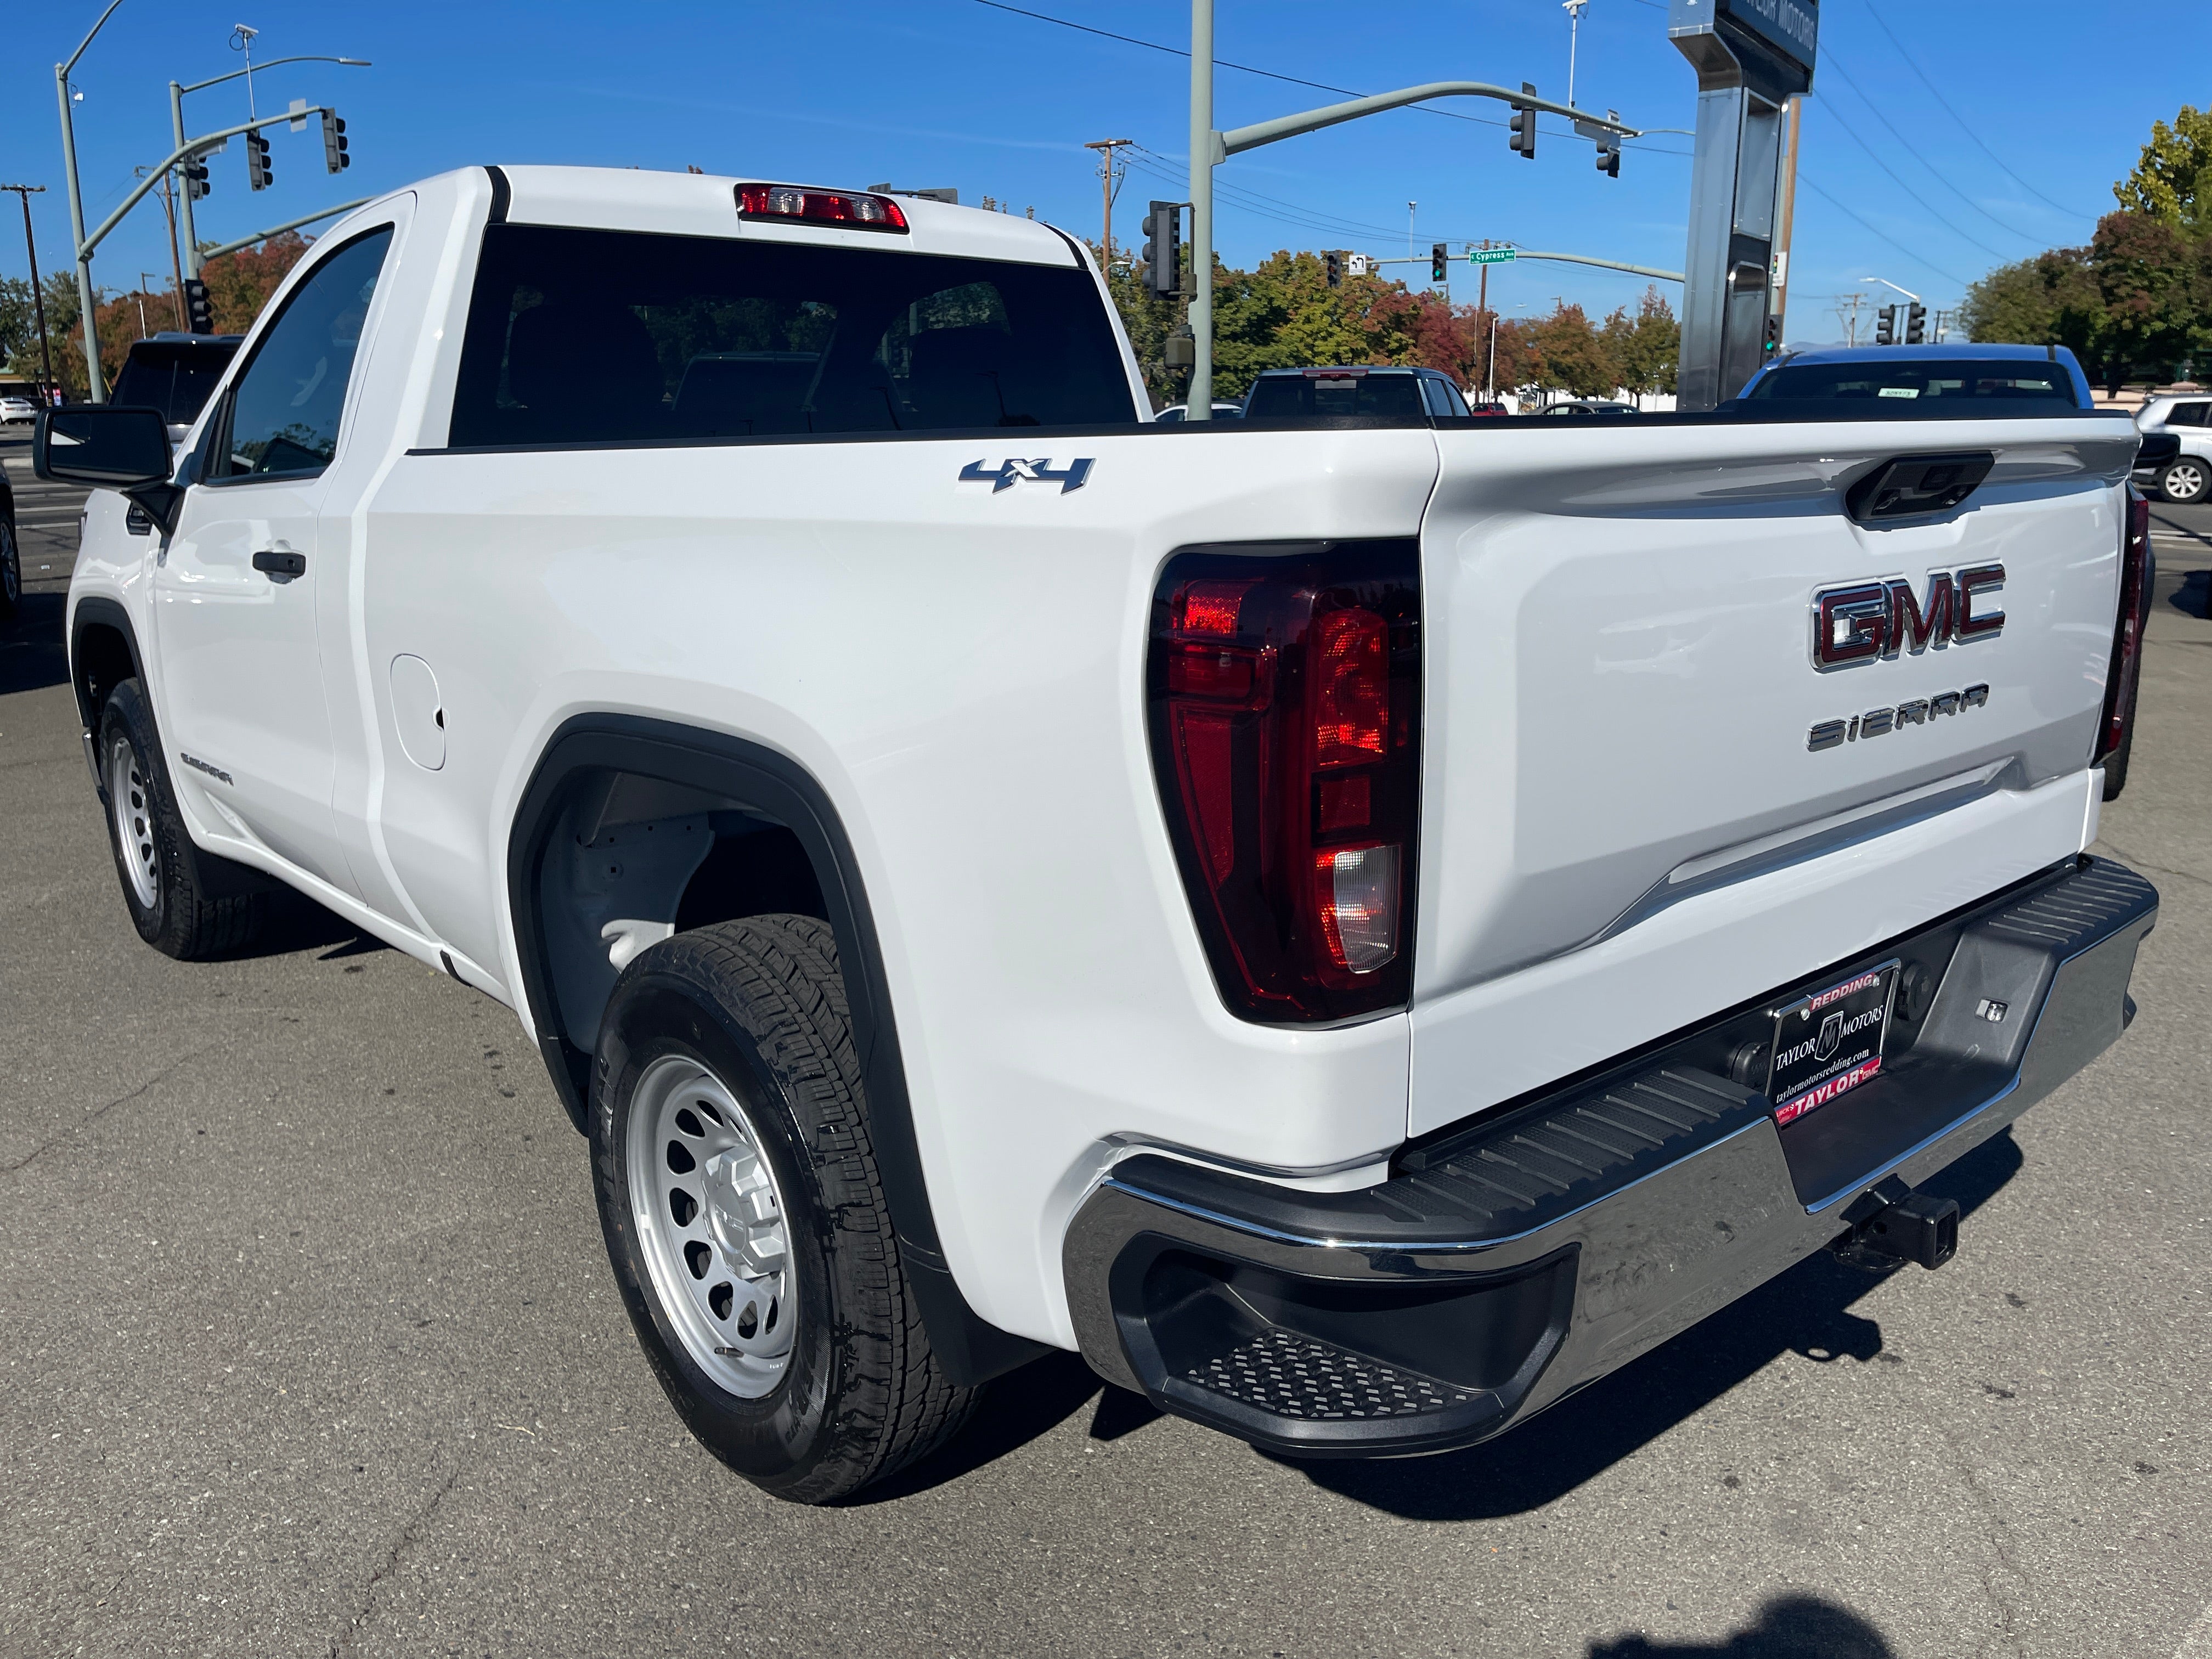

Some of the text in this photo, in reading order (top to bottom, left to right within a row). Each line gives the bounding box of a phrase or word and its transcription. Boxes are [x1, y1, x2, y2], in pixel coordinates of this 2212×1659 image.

[1476, 252, 1505, 261] Cypress
[1809, 563, 2006, 674] GMC
[1806, 682, 1990, 753] SIERRA
[1812, 973, 1873, 1010] REDDING
[1776, 1004, 1883, 1071] TAYLOR MOTORS
[1776, 1048, 1869, 1104] taylormotorsredding.com
[1795, 1069, 1860, 1116] TAYLOR
[1861, 1064, 1880, 1080] GMC
